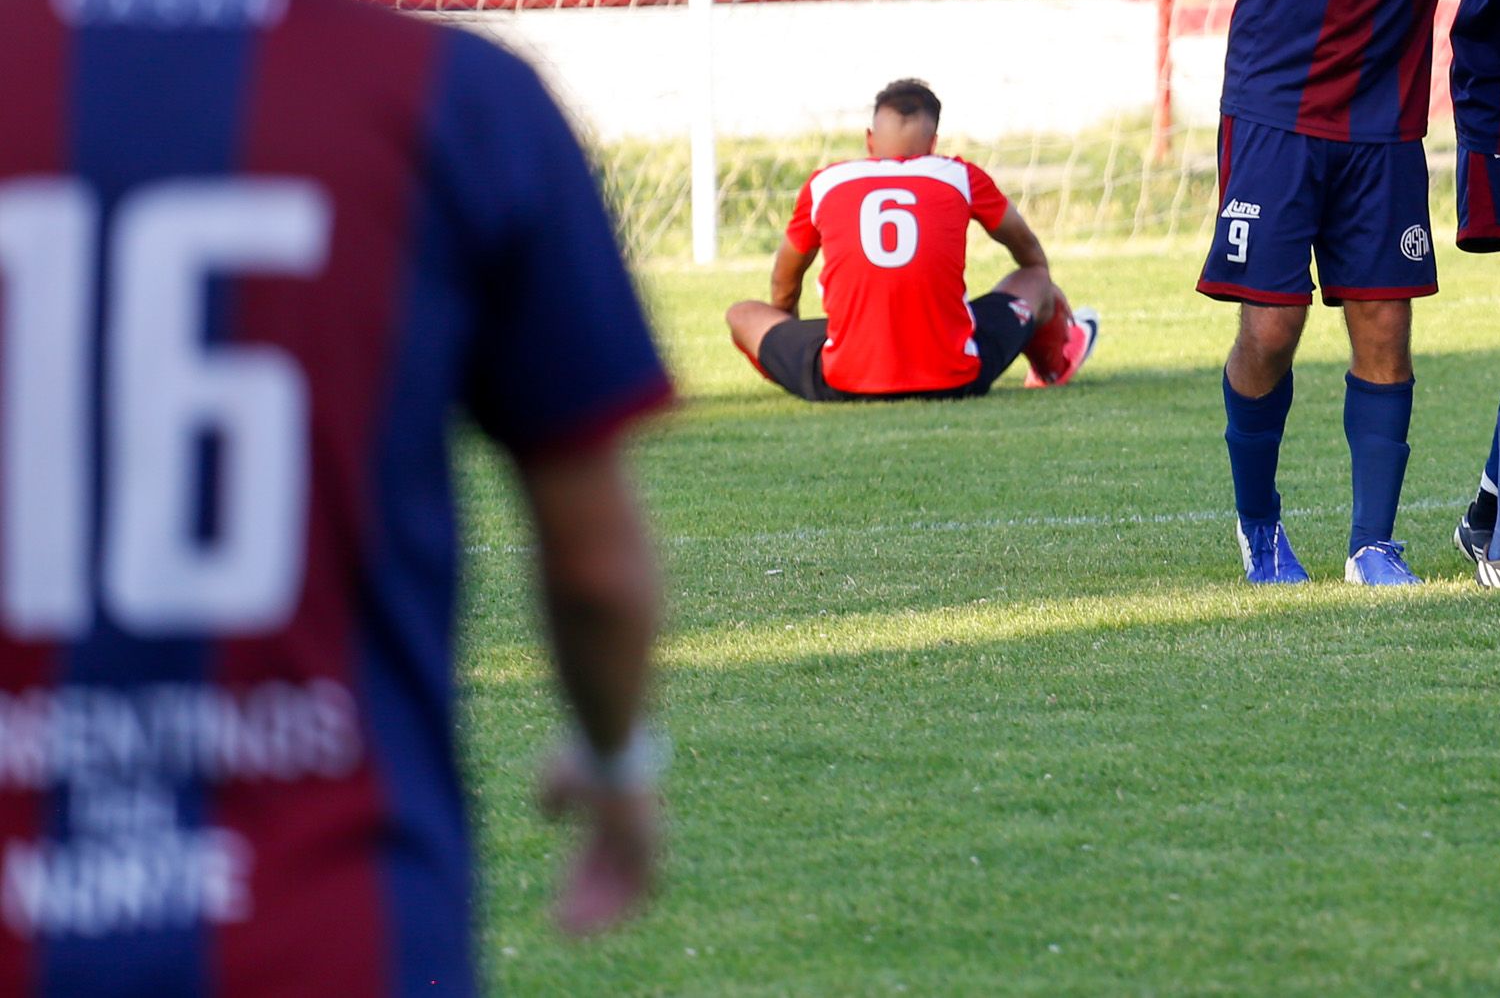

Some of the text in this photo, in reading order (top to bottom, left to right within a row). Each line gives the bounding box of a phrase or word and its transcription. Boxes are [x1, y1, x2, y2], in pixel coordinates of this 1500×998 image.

[859, 188, 919, 269] 6
[1227, 220, 1250, 264] 9
[0, 174, 334, 644] 16
